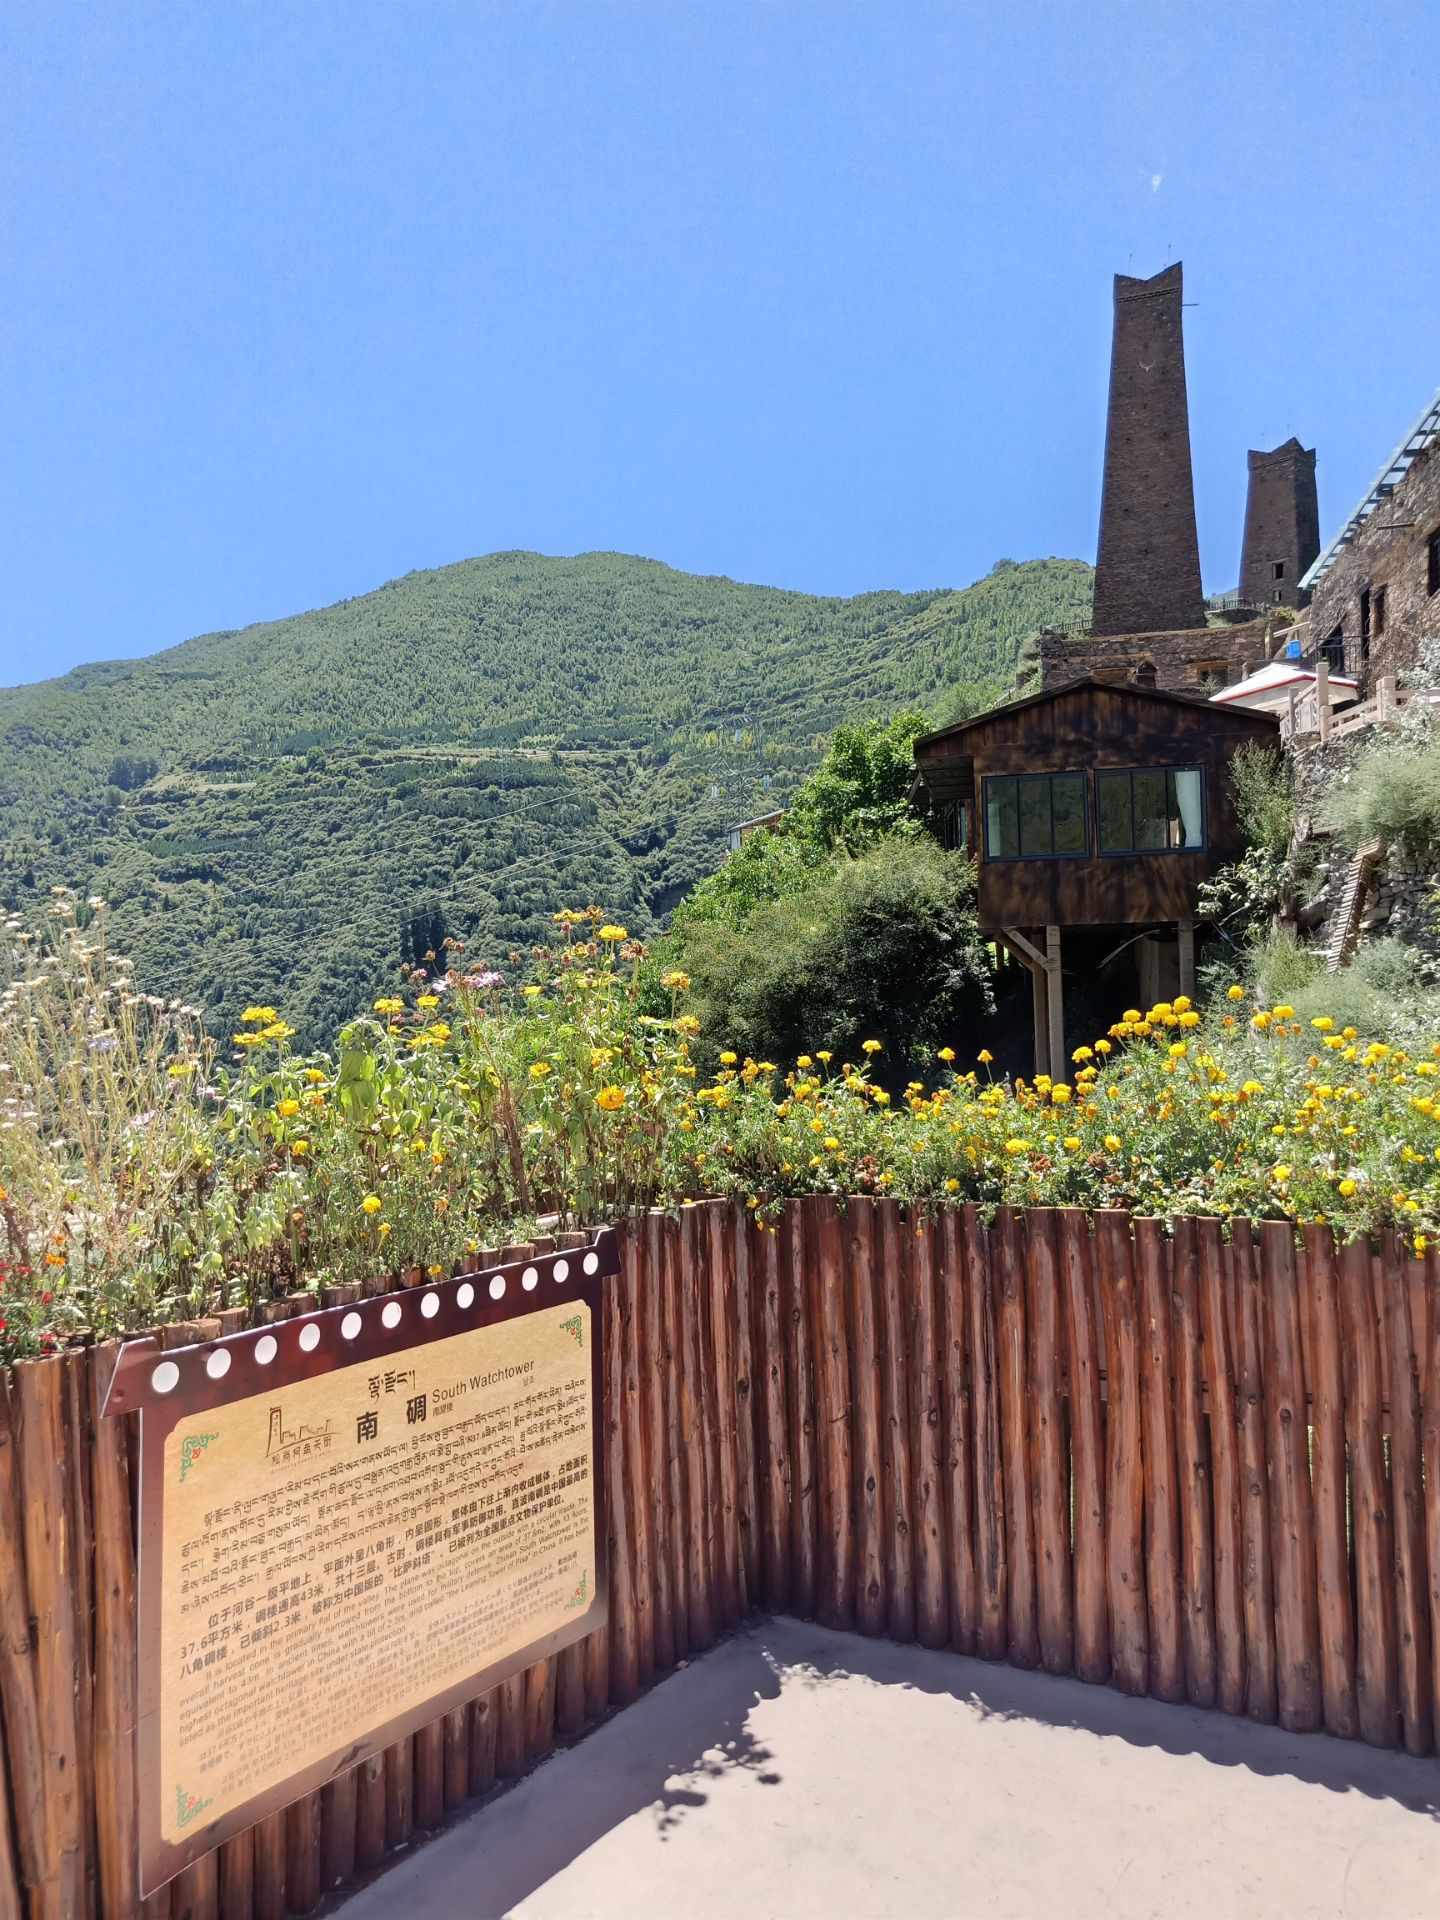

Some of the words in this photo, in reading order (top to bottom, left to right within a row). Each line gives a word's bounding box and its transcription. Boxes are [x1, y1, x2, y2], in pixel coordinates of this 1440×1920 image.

[432, 1380, 466, 1403] South
[469, 1360, 533, 1389] Watchtower
[179, 1684, 208, 1707] overall
[213, 1666, 244, 1689] harvest
[249, 1656, 269, 1671] cone
[285, 1630, 321, 1656] gradually
[325, 1611, 360, 1634] narrowed
[364, 1602, 380, 1616] from
[384, 1596, 395, 1607] the
[399, 1583, 422, 1600] bottom
[436, 1572, 445, 1582] the
[464, 1554, 485, 1569] covers
[499, 1541, 512, 1553] area
[549, 1518, 560, 1529] with
[179, 1689, 224, 1721] equivalent
[278, 1648, 307, 1670] ancient
[338, 1612, 384, 1640] watchtowers
[387, 1603, 404, 1616] were
[408, 1592, 424, 1607] used
[428, 1587, 436, 1597] for
[440, 1575, 463, 1591] military
[519, 1539, 536, 1553] South
[538, 1523, 570, 1544] Watchtower
[580, 1515, 588, 1525] the
[179, 1709, 211, 1734] highest
[214, 1686, 256, 1715] octagonal
[258, 1662, 304, 1692] watchtower
[317, 1645, 339, 1663] China
[342, 1636, 356, 1650] with
[367, 1626, 375, 1638] tilt
[409, 1604, 421, 1617] and
[424, 1593, 444, 1610] called
[461, 1574, 485, 1592] Leaning
[488, 1565, 505, 1579] Tower
[564, 1532, 573, 1542] has
[575, 1525, 588, 1536] been
[225, 1648, 256, 1671] located
[270, 1636, 282, 1649] the
[286, 1621, 315, 1643] primary
[319, 1613, 330, 1625] flat
[343, 1602, 355, 1614] the
[385, 1583, 396, 1595] The
[400, 1573, 418, 1590] plane
[421, 1566, 434, 1578] was
[437, 1549, 468, 1570] octagonal
[481, 1540, 490, 1550] the
[492, 1529, 514, 1545] outside
[517, 1522, 528, 1534] with
[536, 1509, 556, 1525] circular
[578, 1496, 588, 1506] The
[179, 1726, 202, 1747] listed
[218, 1712, 231, 1726] the
[233, 1690, 271, 1717] important
[275, 1673, 307, 1696] heritage
[310, 1665, 323, 1678] site
[326, 1652, 348, 1670] under
[350, 1643, 367, 1658] state
